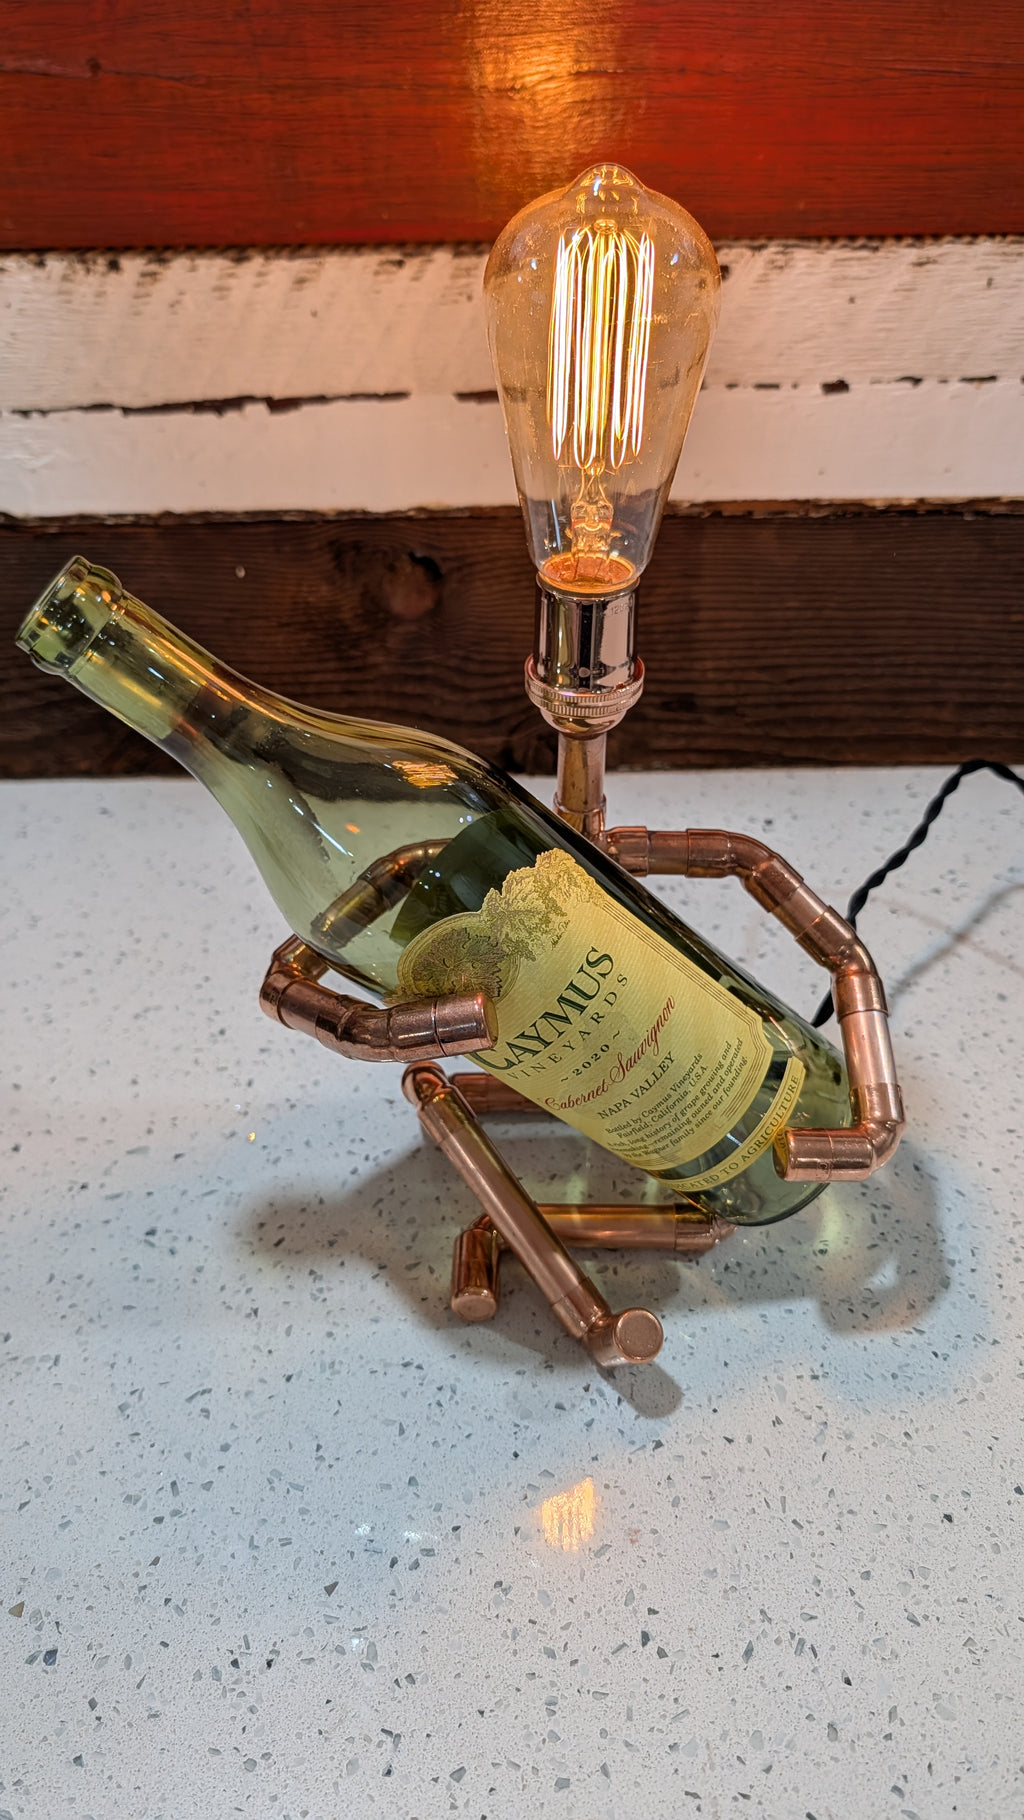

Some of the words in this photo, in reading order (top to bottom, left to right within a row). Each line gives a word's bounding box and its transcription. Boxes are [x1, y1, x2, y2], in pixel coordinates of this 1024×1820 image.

[470, 945, 614, 1071] CAYMUS
[506, 973, 629, 1081] VINEYARDS
[544, 1078, 611, 1111] Cabernet
[608, 994, 676, 1084] Sauvignon
[597, 1098, 632, 1119] NAPA
[630, 1051, 675, 1099] VALLEY
[605, 1121, 633, 1134] Bottled
[632, 1113, 643, 1125] by
[641, 1093, 672, 1118] Caymus
[670, 1053, 703, 1093] Vineyards
[646, 1122, 672, 1139] history
[671, 1112, 682, 1125] of
[679, 1095, 700, 1118] grape
[699, 1060, 724, 1097] growing
[721, 1040, 732, 1061] and
[651, 1089, 692, 1122] California,
[670, 1126, 695, 1147] family
[695, 1109, 713, 1128] since
[712, 1095, 724, 1111] our
[722, 1055, 748, 1097] founding.
[691, 1093, 714, 1118] owned
[712, 1075, 726, 1094] and
[724, 1037, 743, 1076] operated
[719, 1161, 739, 1176] TO
[741, 1076, 799, 1163] AGRICULTURE
